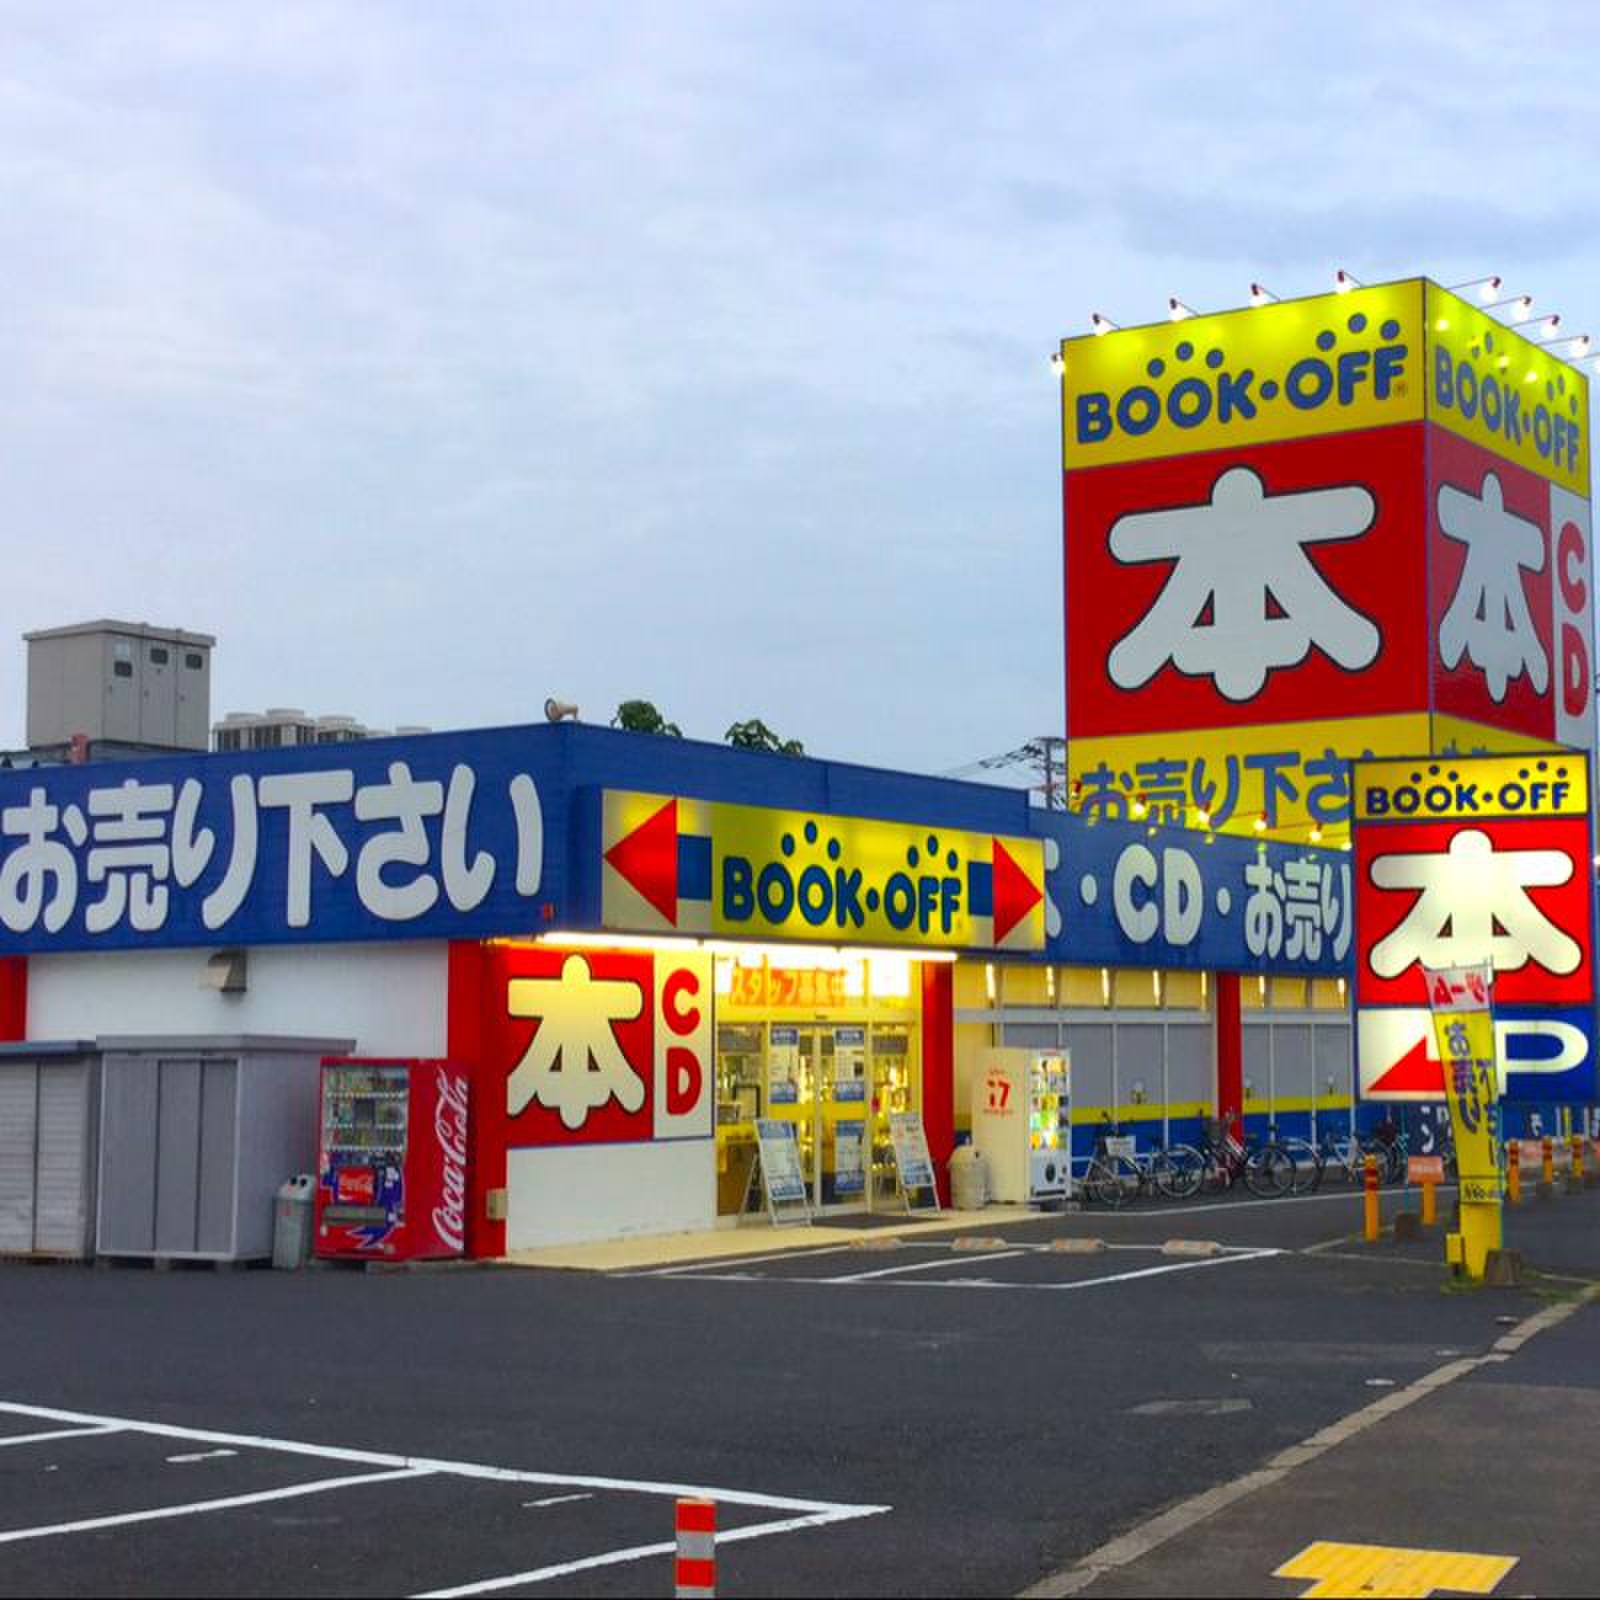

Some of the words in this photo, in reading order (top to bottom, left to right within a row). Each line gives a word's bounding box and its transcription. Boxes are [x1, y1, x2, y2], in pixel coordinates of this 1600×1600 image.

[1108, 466, 1381, 702] 本
[1438, 472, 1549, 703] 本
[0, 761, 543, 933] お売り下さい
[1081, 747, 1375, 830] お売り下さ
[1370, 829, 1582, 980] 本
[507, 955, 645, 1129] 本
[1493, 1020, 1589, 1098] P
